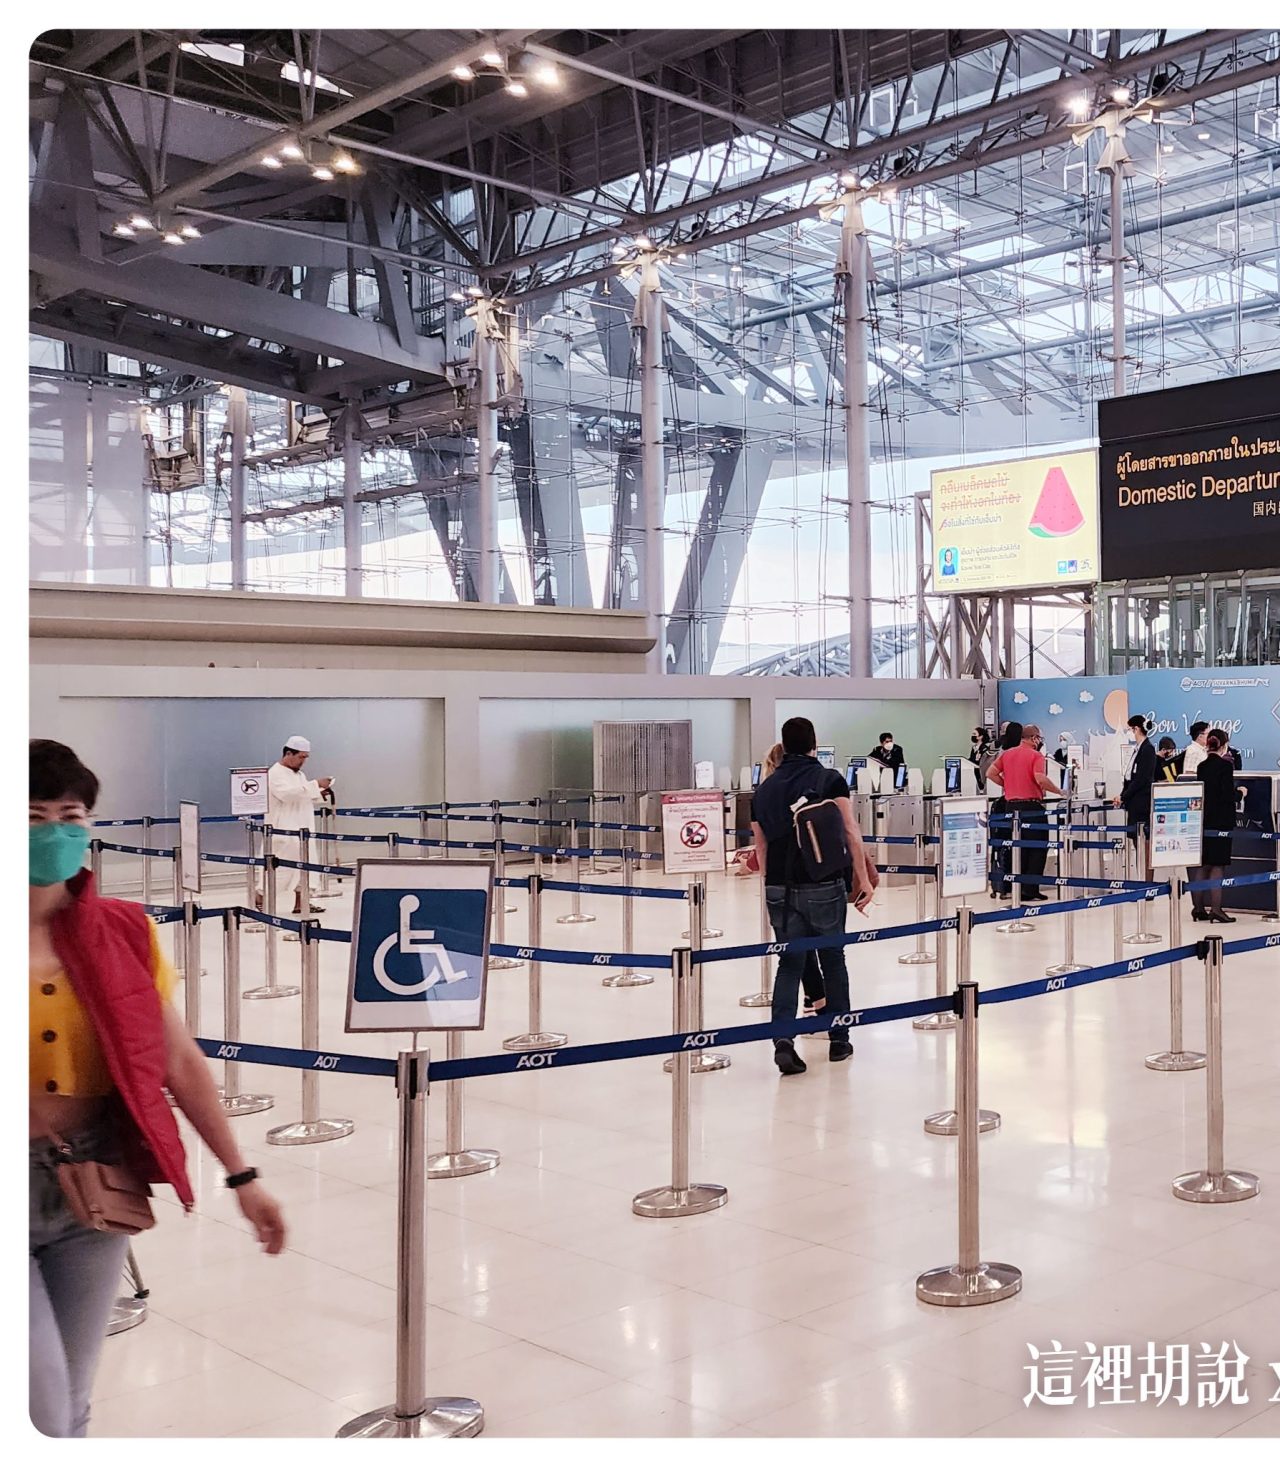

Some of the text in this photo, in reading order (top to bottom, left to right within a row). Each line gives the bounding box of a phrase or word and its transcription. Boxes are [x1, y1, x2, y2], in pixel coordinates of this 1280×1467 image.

[1118, 483, 1197, 508] Domestic
[1143, 710, 1178, 738] Bon
[1003, 874, 1016, 882] AOT
[1222, 878, 1234, 886] AOT
[1145, 889, 1159, 898] AOT
[1087, 898, 1103, 908] AOT
[1024, 907, 1041, 916] AOT
[940, 919, 959, 929] AOT
[857, 931, 879, 942] AOT
[766, 942, 790, 953] AOT
[516, 948, 535, 959] AOT
[592, 954, 611, 964] AOT
[1128, 957, 1145, 971] AOT
[1046, 977, 1067, 991] AOT
[831, 1012, 864, 1028] AOT
[683, 1032, 719, 1048] AOT
[217, 1045, 242, 1058] AOT
[313, 1055, 341, 1069] AOT
[516, 1052, 557, 1068] AOT
